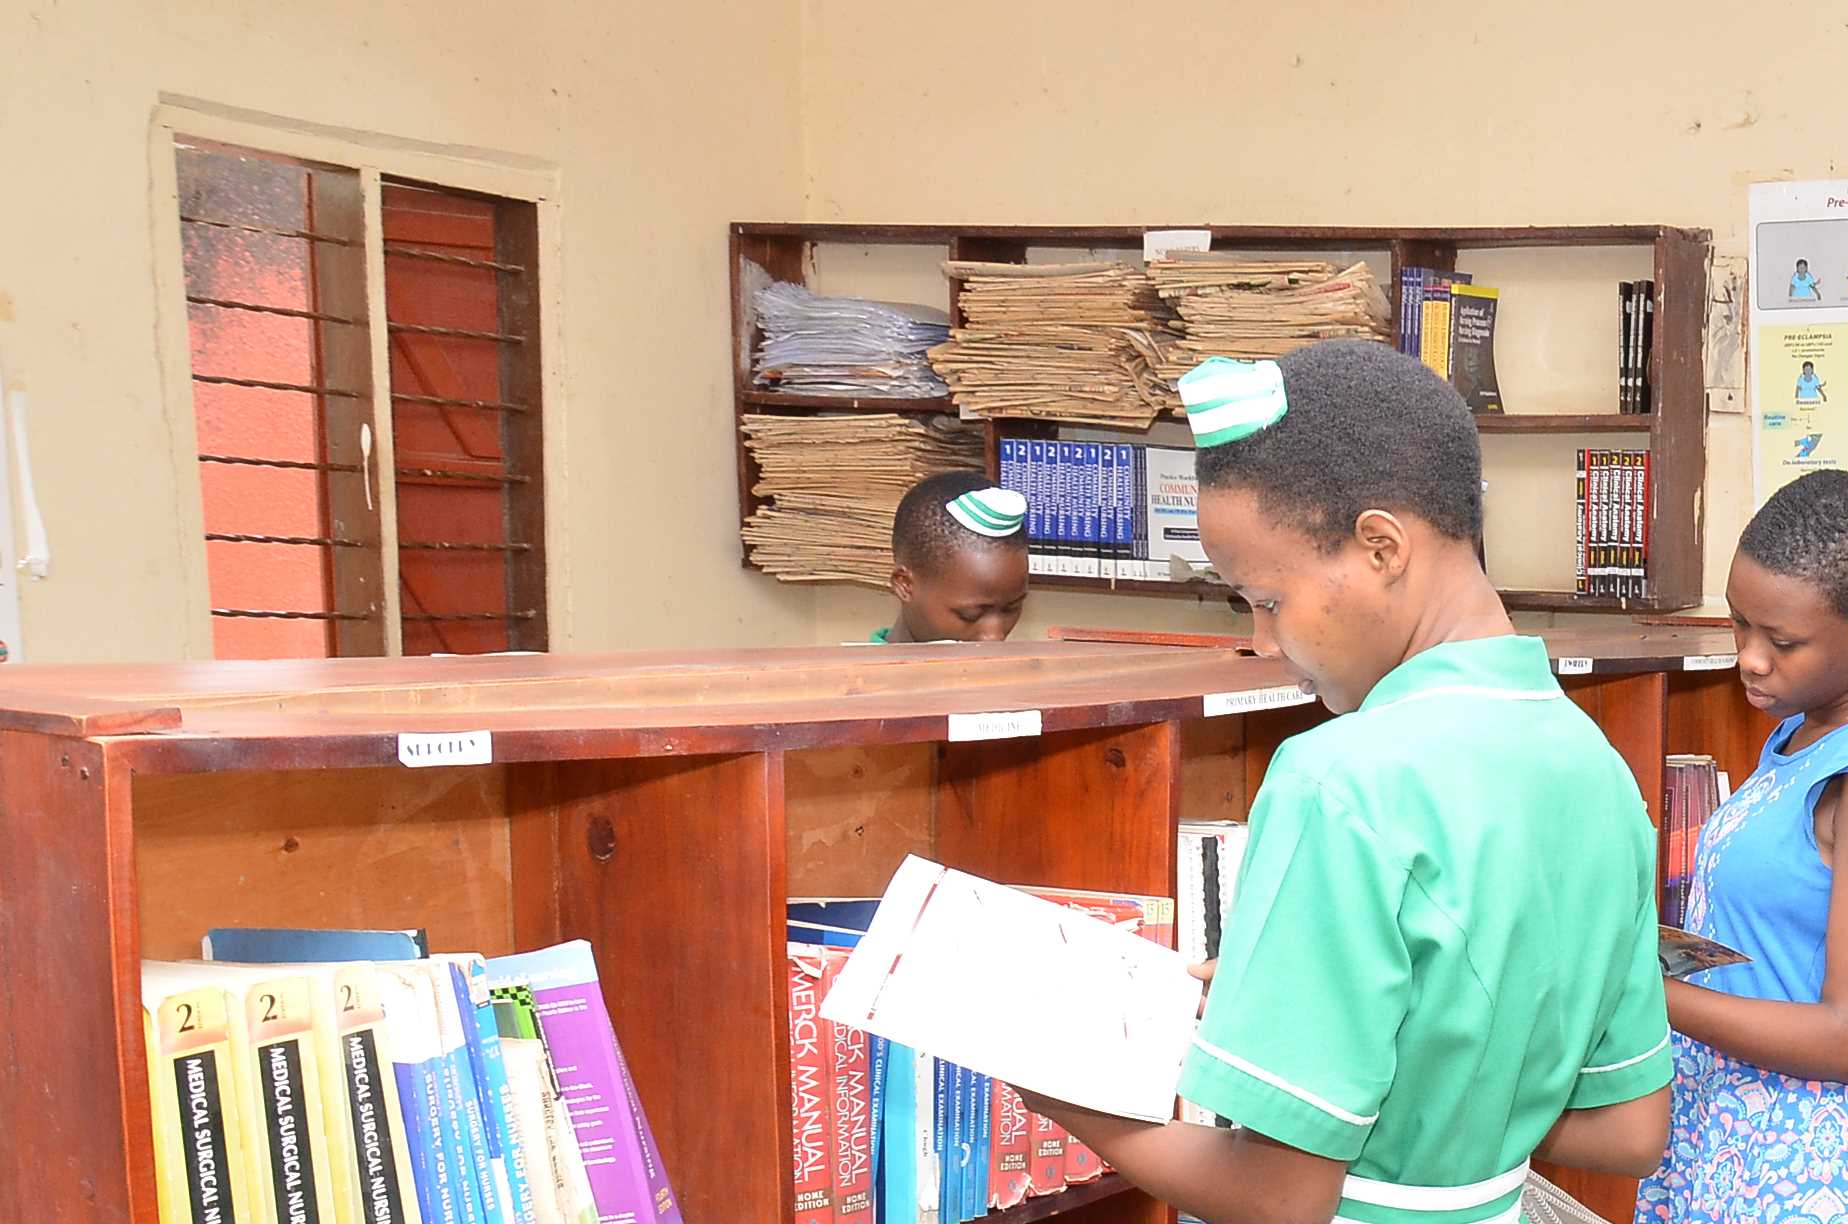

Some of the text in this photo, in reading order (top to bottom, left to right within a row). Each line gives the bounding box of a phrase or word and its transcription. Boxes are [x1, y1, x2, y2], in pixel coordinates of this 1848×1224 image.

[1590, 503, 1598, 541] Anatomy
[1635, 503, 1643, 541] Anatomy
[260, 993, 278, 1023] 2
[341, 985, 353, 1012] 2
[177, 1003, 194, 1033] 2
[270, 1046, 292, 1113] MEDICAL
[348, 1035, 371, 1101] MEDICAL
[793, 965, 824, 1181] MERCK MANUAL
[873, 1059, 881, 1095] CLINICAL
[185, 1058, 208, 1127] MEDICAL
[358, 1102, 383, 1175] SURGICAL
[833, 1075, 854, 1186] INFORMATION
[847, 1070, 869, 1184] MANUAL
[1043, 1140, 1061, 1149] HOME
[194, 1128, 218, 1205] SURGICAL
[278, 1116, 301, 1189] SURGICAL
[1038, 1147, 1062, 1156] EDITION
[842, 1200, 870, 1213] EDITION
[846, 1192, 866, 1203] HOME
